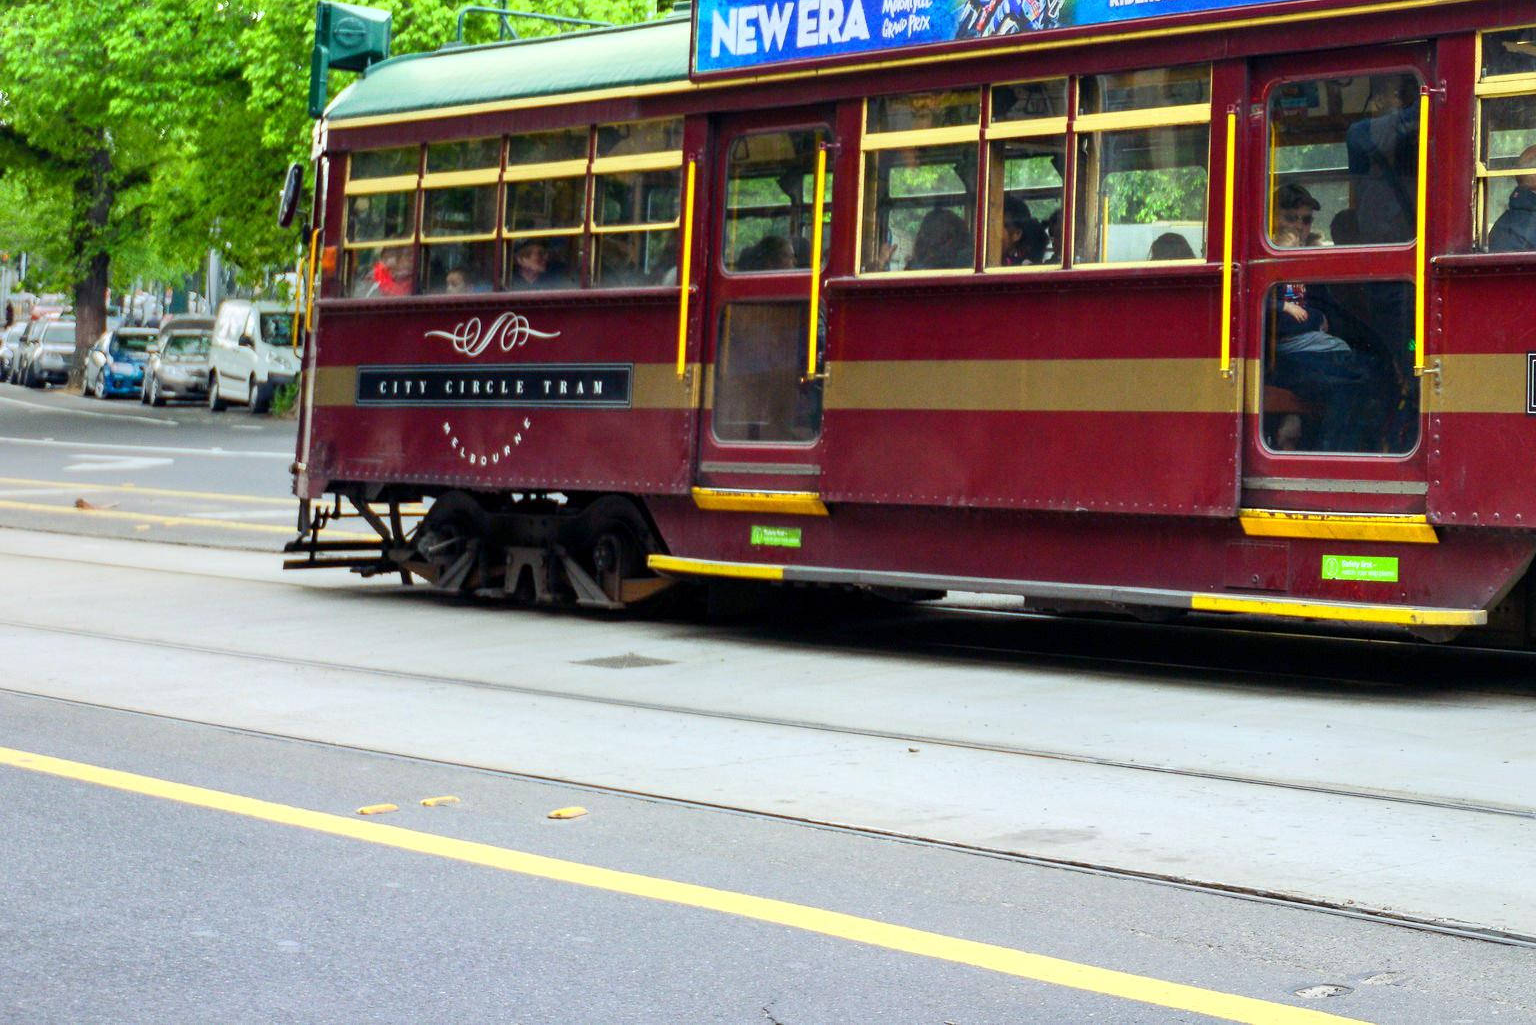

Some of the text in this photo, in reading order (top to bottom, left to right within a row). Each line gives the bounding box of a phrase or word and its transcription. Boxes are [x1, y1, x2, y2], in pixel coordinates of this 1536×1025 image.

[710, 2, 794, 58] NEW
[882, 15, 931, 38] GRAND PRIX
[379, 379, 603, 394] CITY CIRCLE TRAM
[443, 417, 531, 466] MELBOURNE
